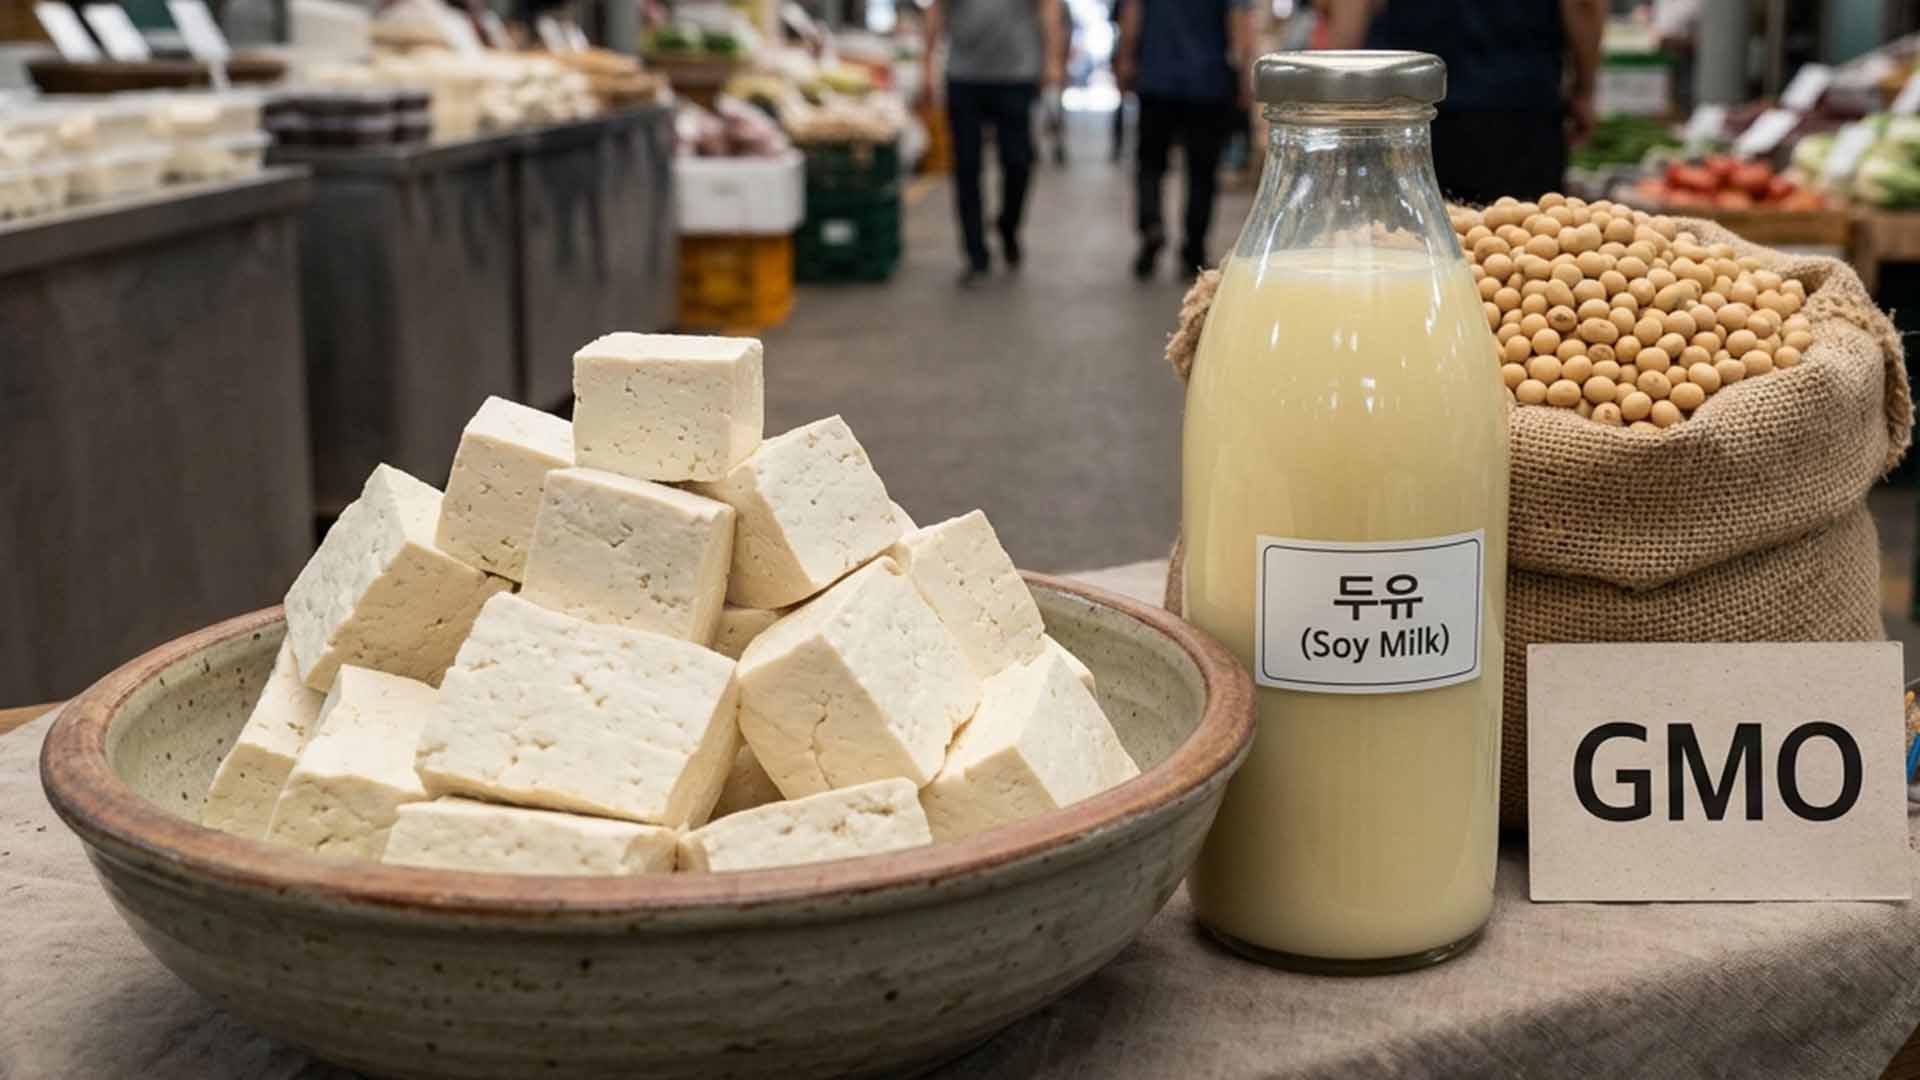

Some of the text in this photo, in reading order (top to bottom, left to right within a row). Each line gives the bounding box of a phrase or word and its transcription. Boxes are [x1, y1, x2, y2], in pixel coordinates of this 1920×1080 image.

[1333, 574, 1424, 621] 두유
[1301, 623, 1450, 664] (Soy Milk)
[1573, 721, 1863, 822] GMO
